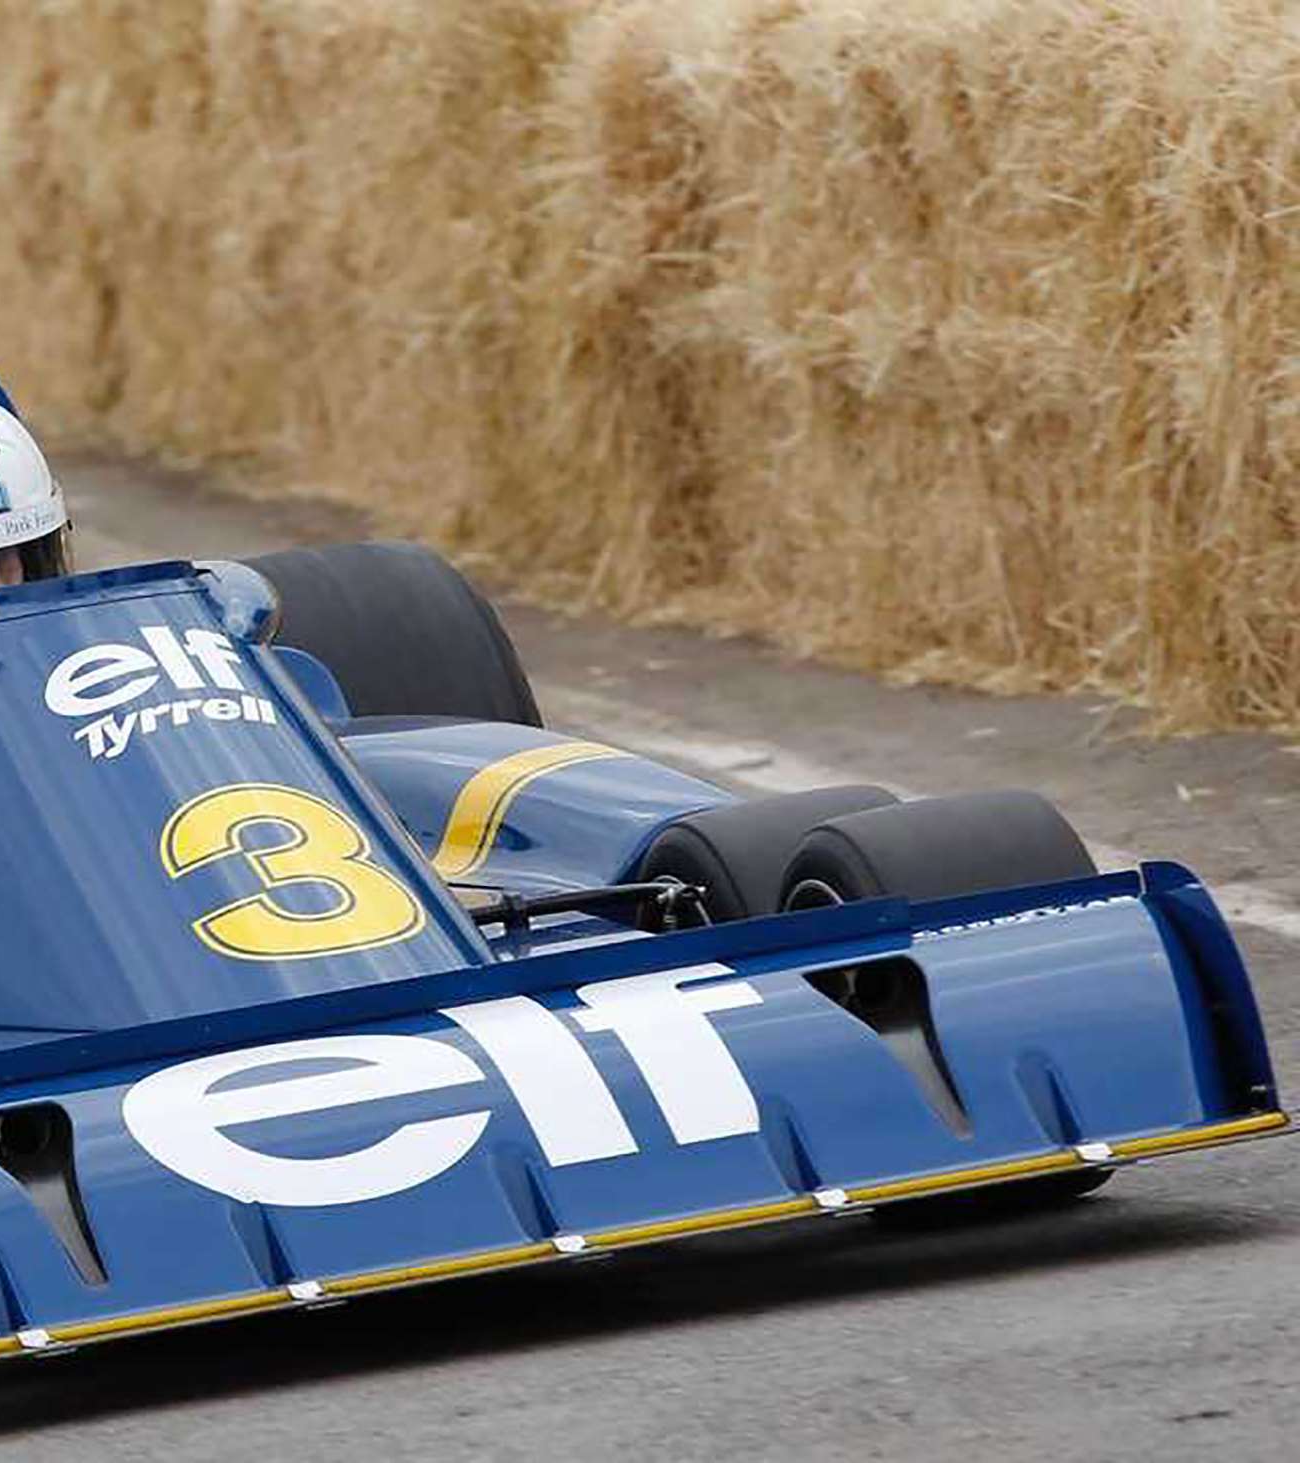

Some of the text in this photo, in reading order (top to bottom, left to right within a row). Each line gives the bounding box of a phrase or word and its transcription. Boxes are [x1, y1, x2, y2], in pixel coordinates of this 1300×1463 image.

[44, 626, 244, 717] elf
[73, 697, 277, 759] Tyrrell
[160, 782, 426, 961] 3
[121, 962, 765, 1207] elf
